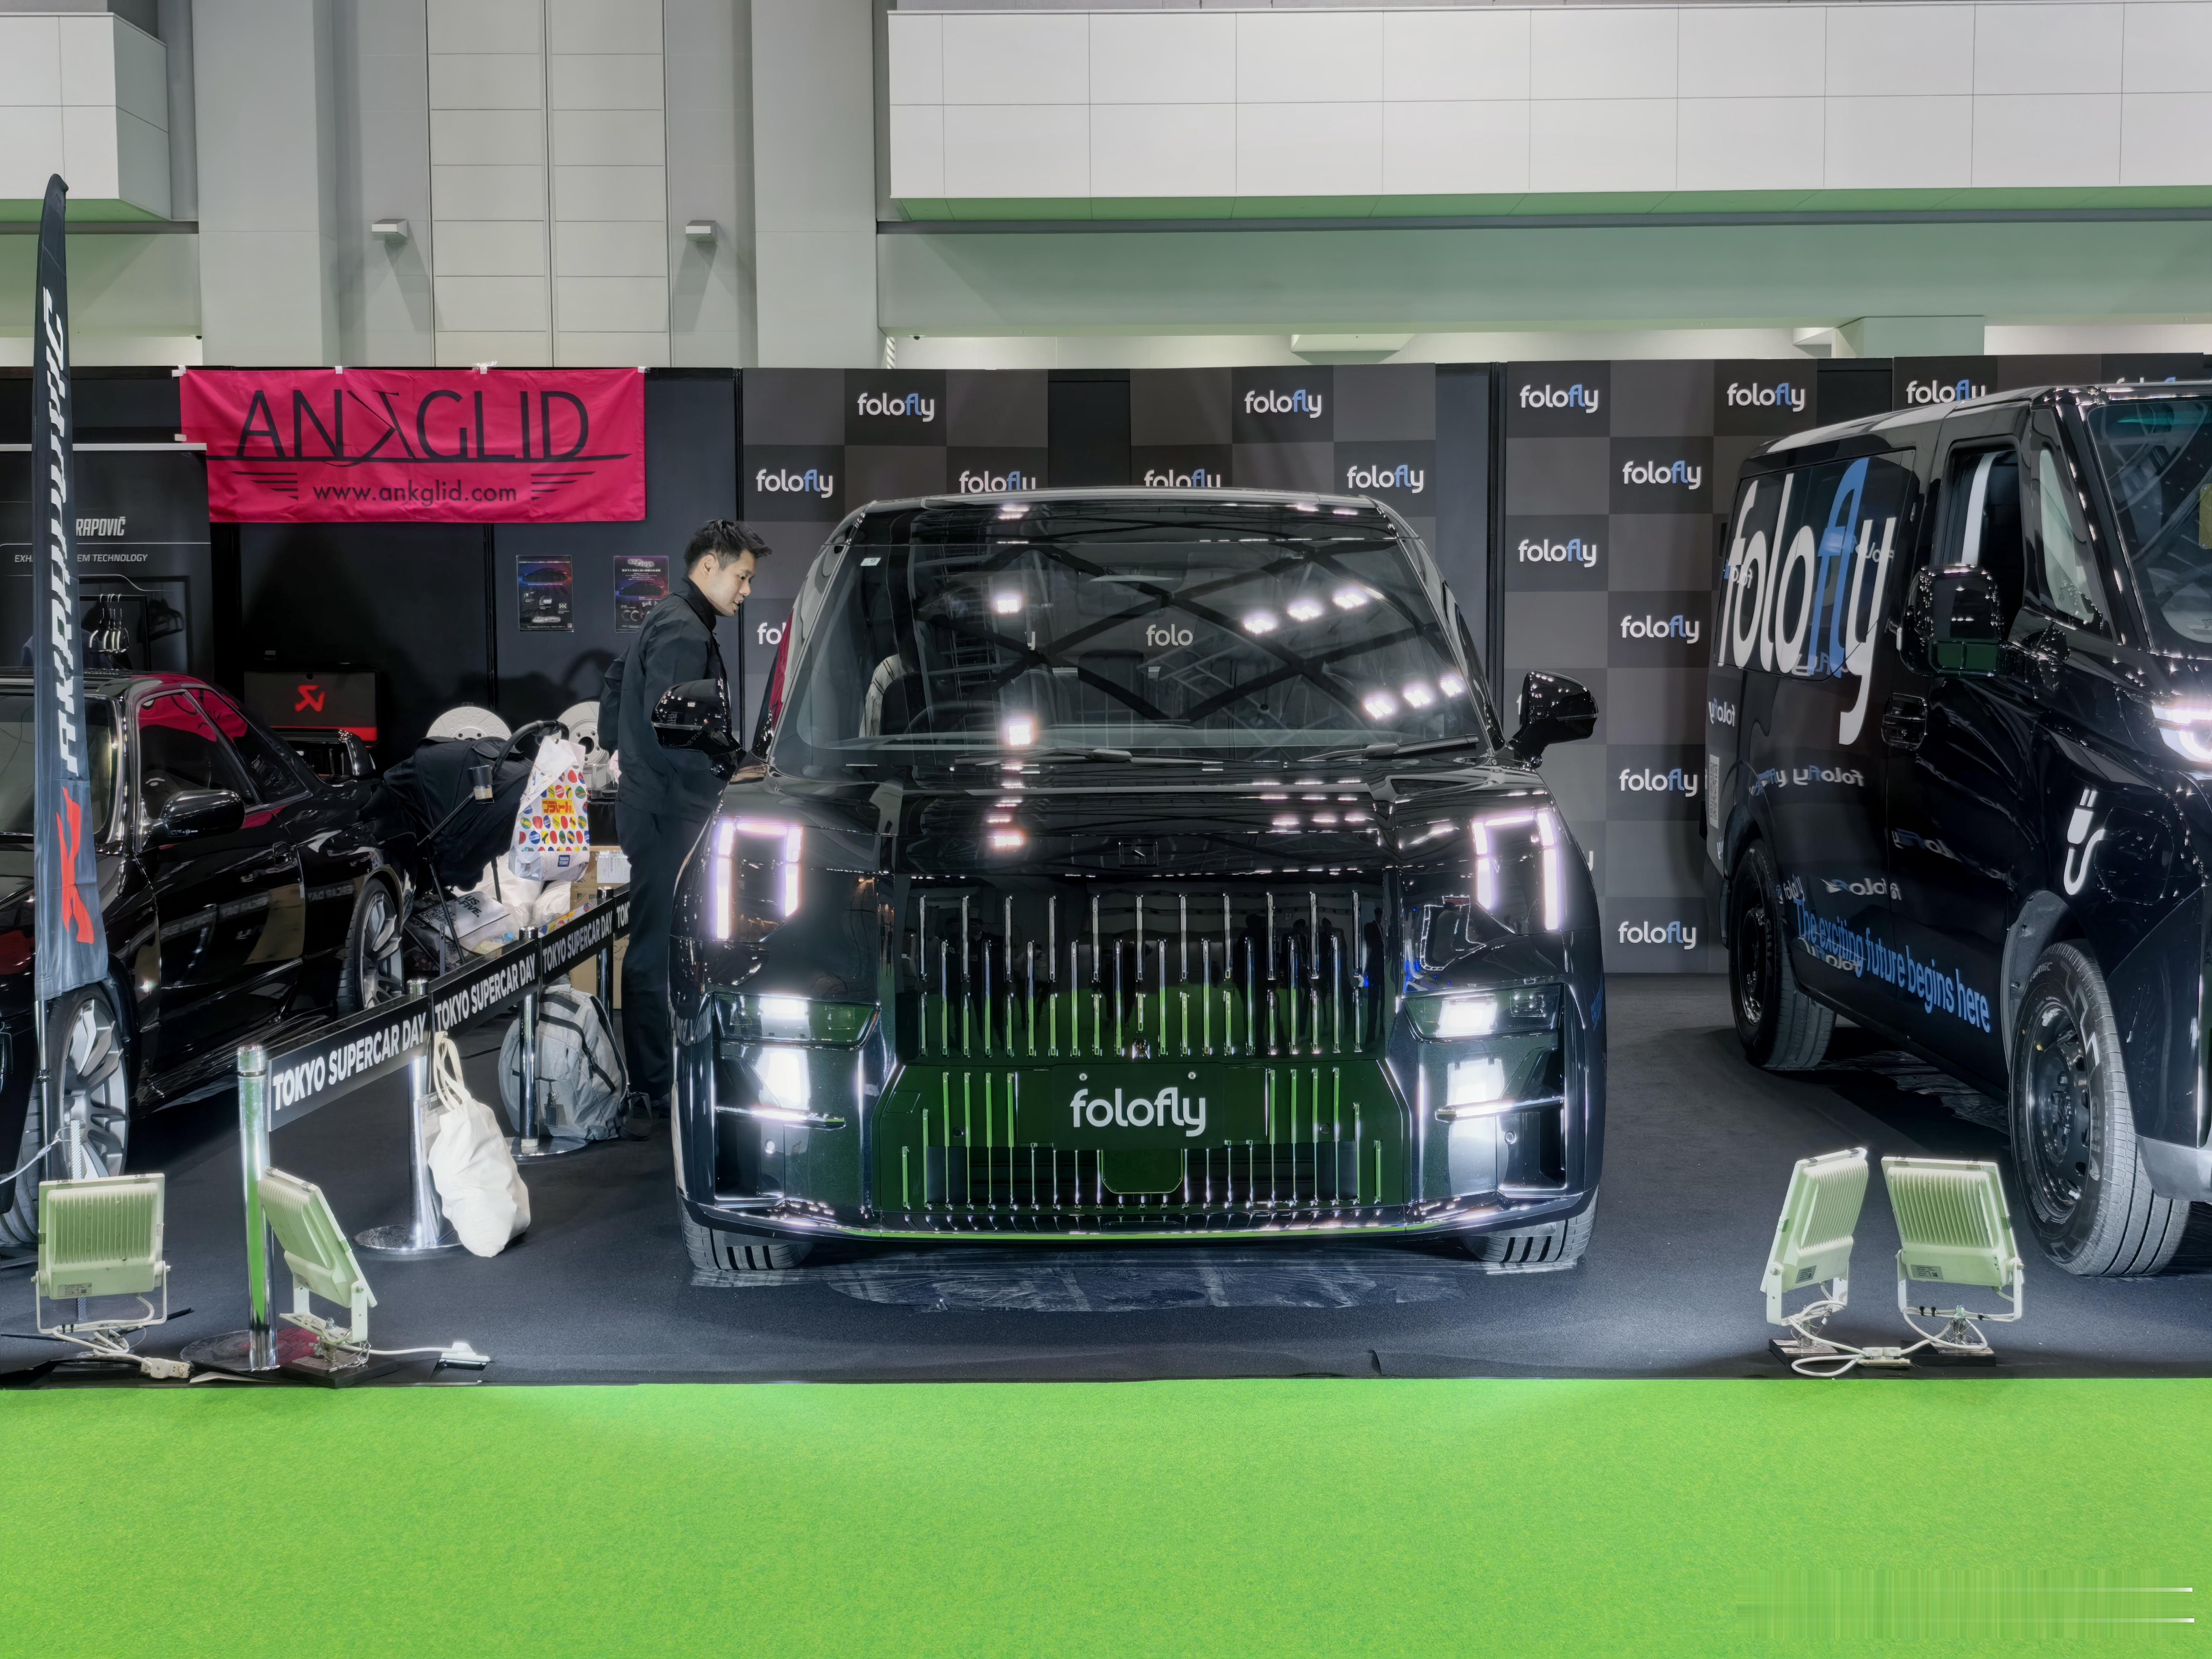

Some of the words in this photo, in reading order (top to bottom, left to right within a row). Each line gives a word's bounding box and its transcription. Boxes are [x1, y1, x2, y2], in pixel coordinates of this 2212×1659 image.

[857, 392, 934, 422] folofly
[1244, 389, 1321, 418] folofly
[1520, 384, 1599, 413] folofly
[1727, 382, 1805, 412] folofly
[756, 469, 833, 498] folofly
[1347, 465, 1424, 493] folofly
[1622, 460, 1701, 490] folofly
[313, 479, 517, 507] www.ankglid.com
[93, 554, 148, 562] TECHNOLOGY
[1518, 539, 1597, 568] folofly
[1718, 457, 1896, 745] folofly
[1146, 624, 1193, 646] folo
[1620, 615, 1699, 644] folofly
[1619, 768, 1697, 797] folofly
[617, 903, 631, 930] TOK
[542, 941, 566, 974] TOKYO
[567, 925, 600, 959] SUPERCAR
[601, 911, 613, 938] DAY
[1618, 921, 1696, 950] folofly
[1793, 898, 1817, 944] The
[1819, 916, 1865, 978] exciting
[1865, 927, 1905, 987] future
[1906, 945, 1955, 1013] begins
[1955, 968, 1991, 1033] here
[435, 989, 469, 1031] TOKYO
[471, 963, 519, 1014] SUPERCAR
[519, 953, 536, 986] DAY
[273, 1056, 325, 1111] TOKYO
[328, 1024, 400, 1085] SUPERCAR
[402, 1012, 426, 1051] DAY
[1070, 1087, 1206, 1137] folofly
